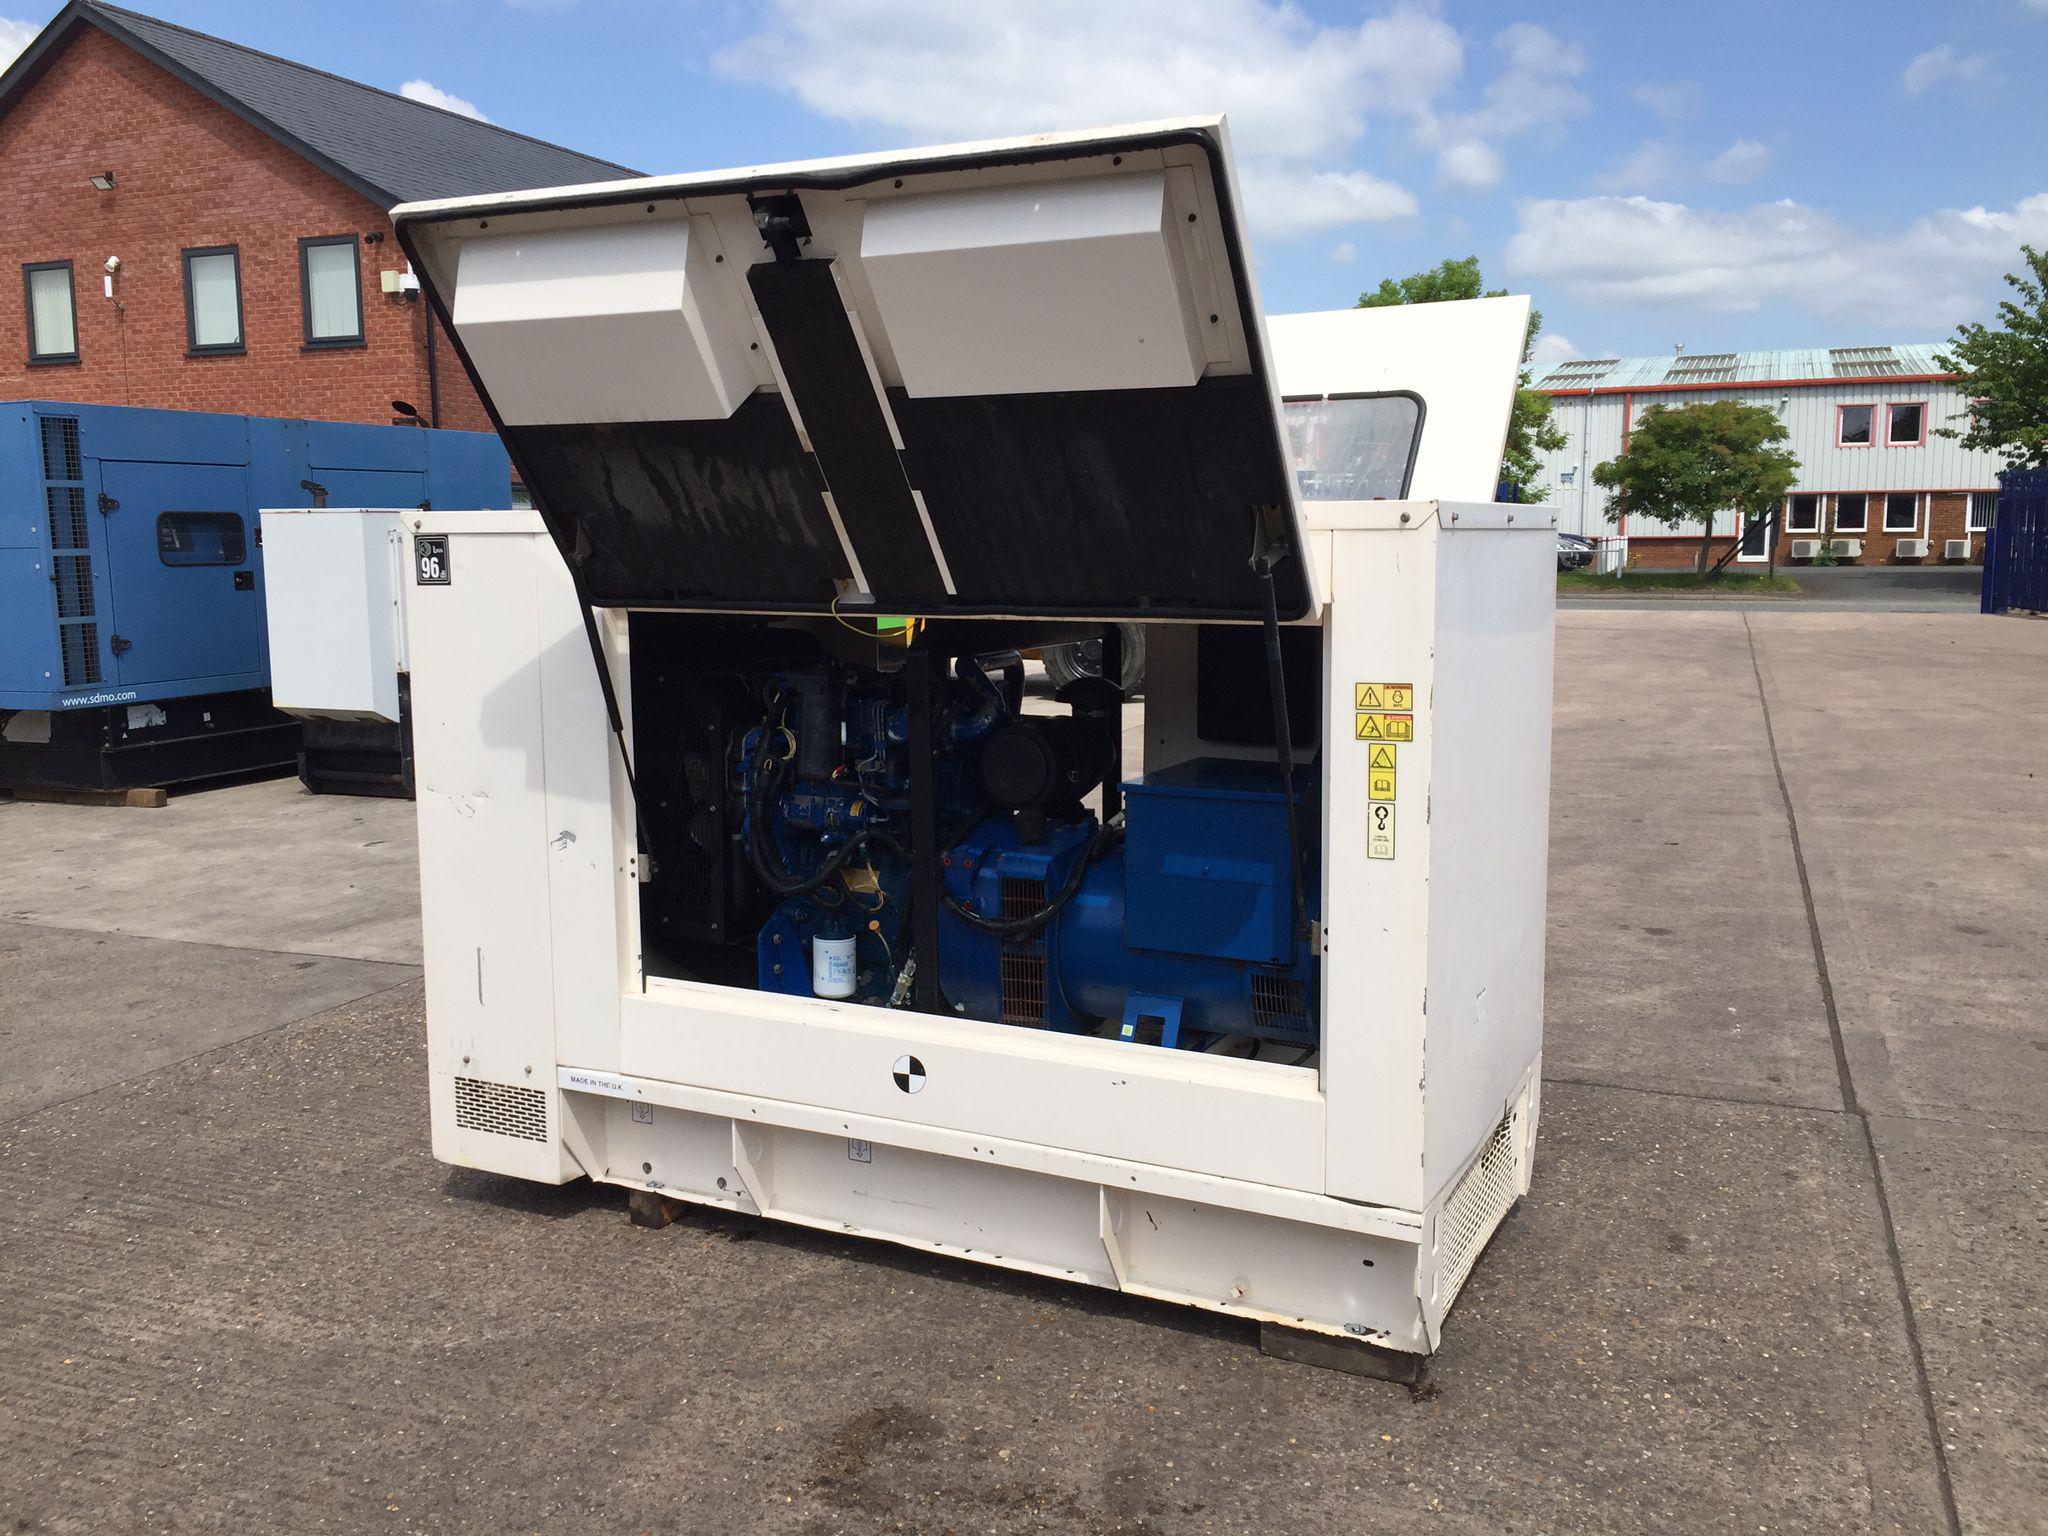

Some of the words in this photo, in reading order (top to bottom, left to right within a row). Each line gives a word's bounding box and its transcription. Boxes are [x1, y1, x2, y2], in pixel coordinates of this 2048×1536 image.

[421, 557, 440, 578] 96
[62, 691, 136, 706] www.sdmo.com
[570, 1076, 588, 1085] MADE
[598, 1080, 610, 1088] THE
